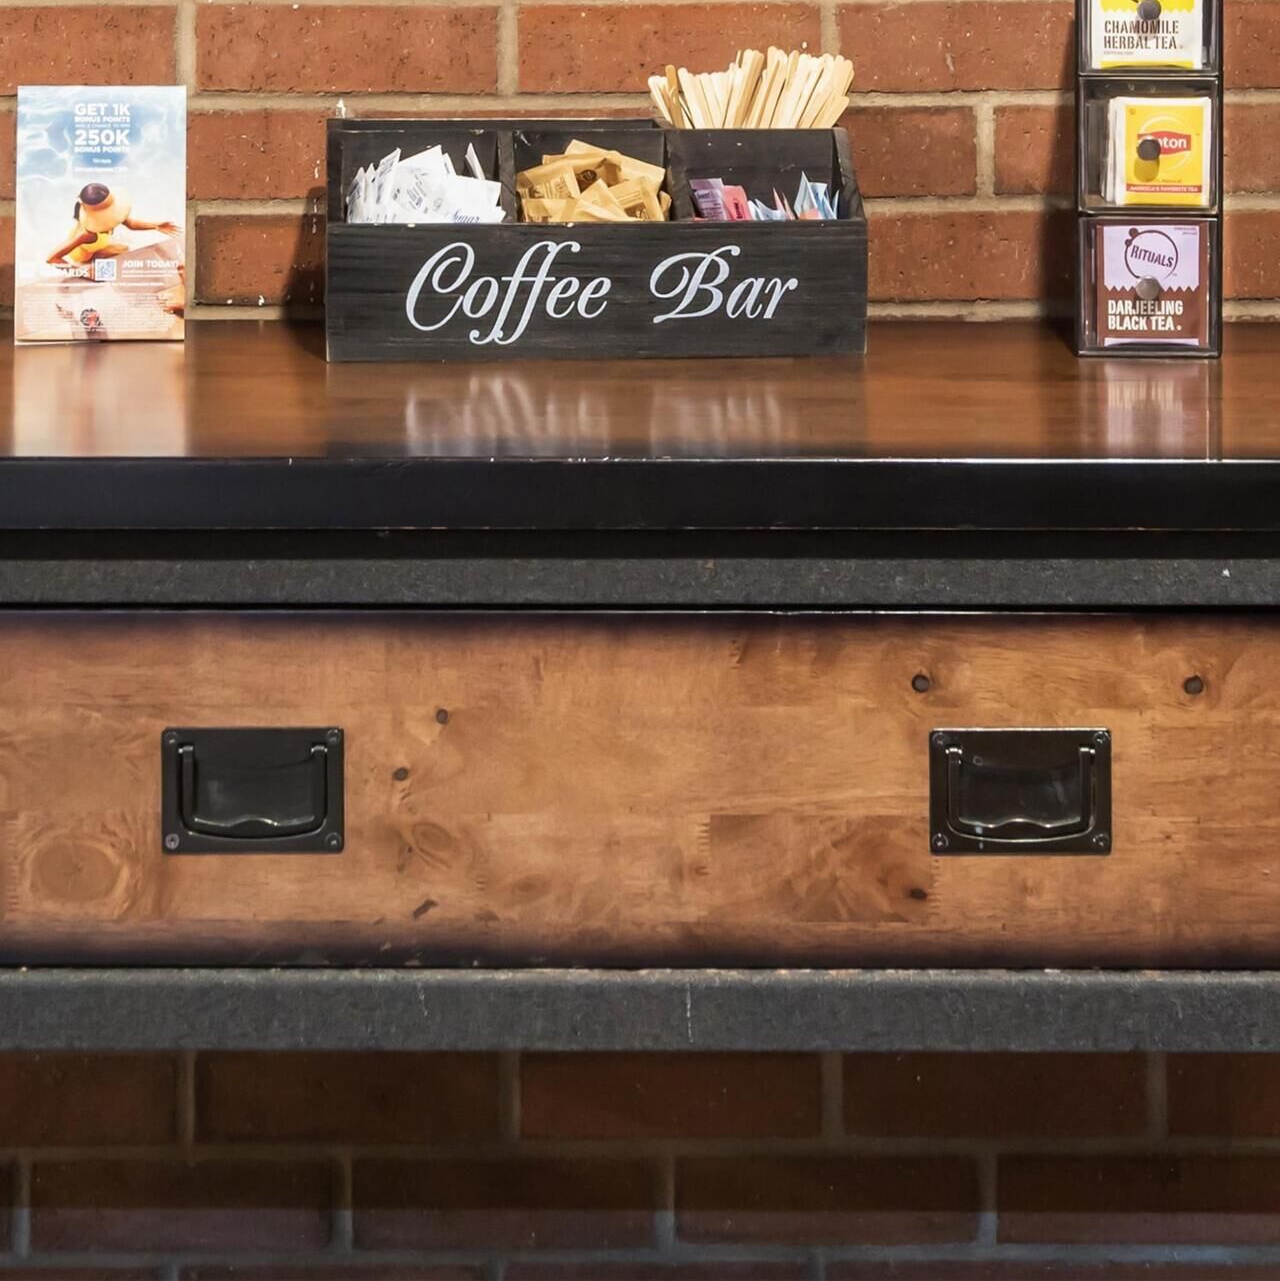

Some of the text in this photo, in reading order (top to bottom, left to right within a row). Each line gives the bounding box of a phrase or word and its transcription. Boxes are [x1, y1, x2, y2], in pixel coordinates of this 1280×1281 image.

[1104, 20, 1180, 35] CHAMOMILE
[1103, 35, 1178, 50] HERBAL TEA
[74, 102, 131, 116] GET 1K
[74, 129, 131, 146] 250K
[122, 260, 144, 268] JOIN
[1130, 244, 1175, 268] RITUALS
[405, 240, 799, 346] Coffee Bar
[1107, 299, 1184, 316] DARJEELING
[1107, 315, 1148, 331] BLACK
